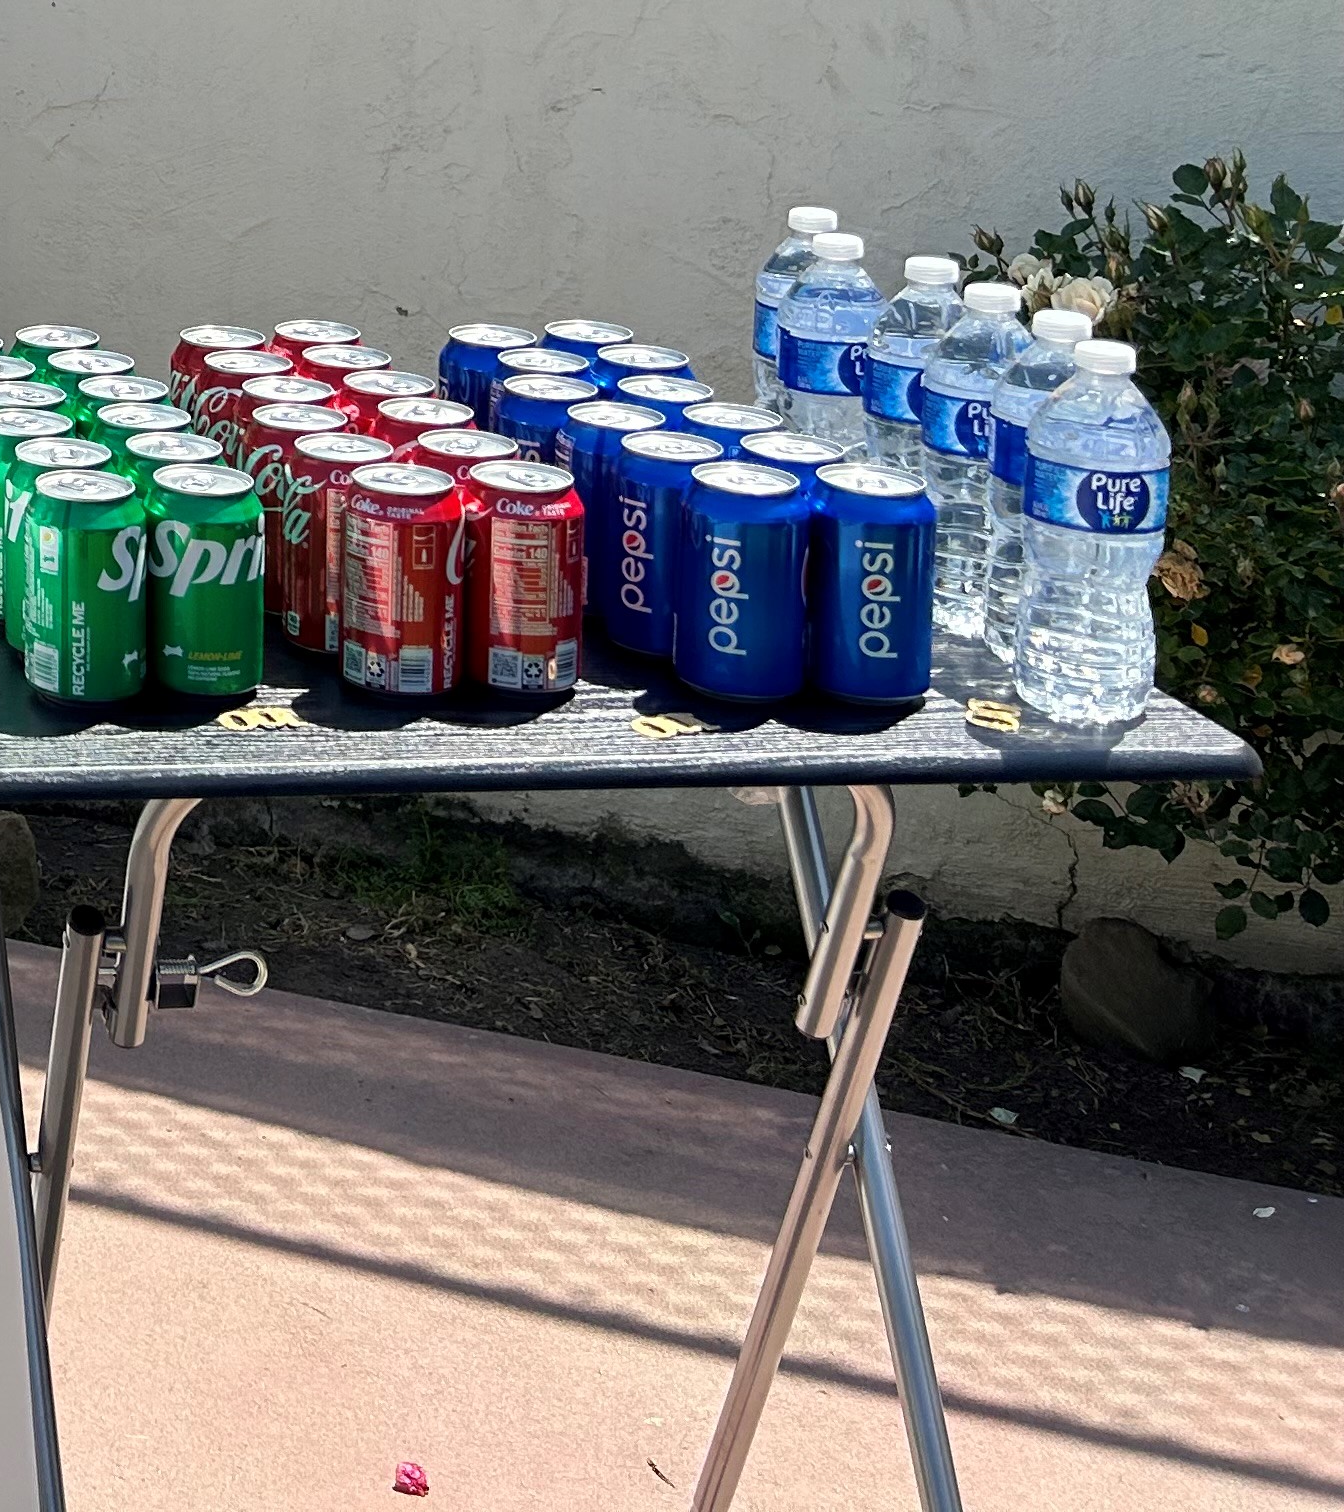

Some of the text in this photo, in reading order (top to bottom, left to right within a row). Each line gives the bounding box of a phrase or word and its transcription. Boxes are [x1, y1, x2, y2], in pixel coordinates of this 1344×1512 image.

[1091, 473, 1141, 492] Pure
[351, 494, 385, 516] Coke
[496, 497, 535, 516] Coke
[1097, 492, 1135, 514] Life
[371, 546, 389, 560] 140
[529, 548, 548, 560] 140
[619, 495, 655, 614] pepsi
[705, 534, 749, 656] pepsi
[854, 539, 902, 659] pepsi
[71, 600, 85, 696] RECYCLE ME
[443, 621, 456, 689] RECYCLE
